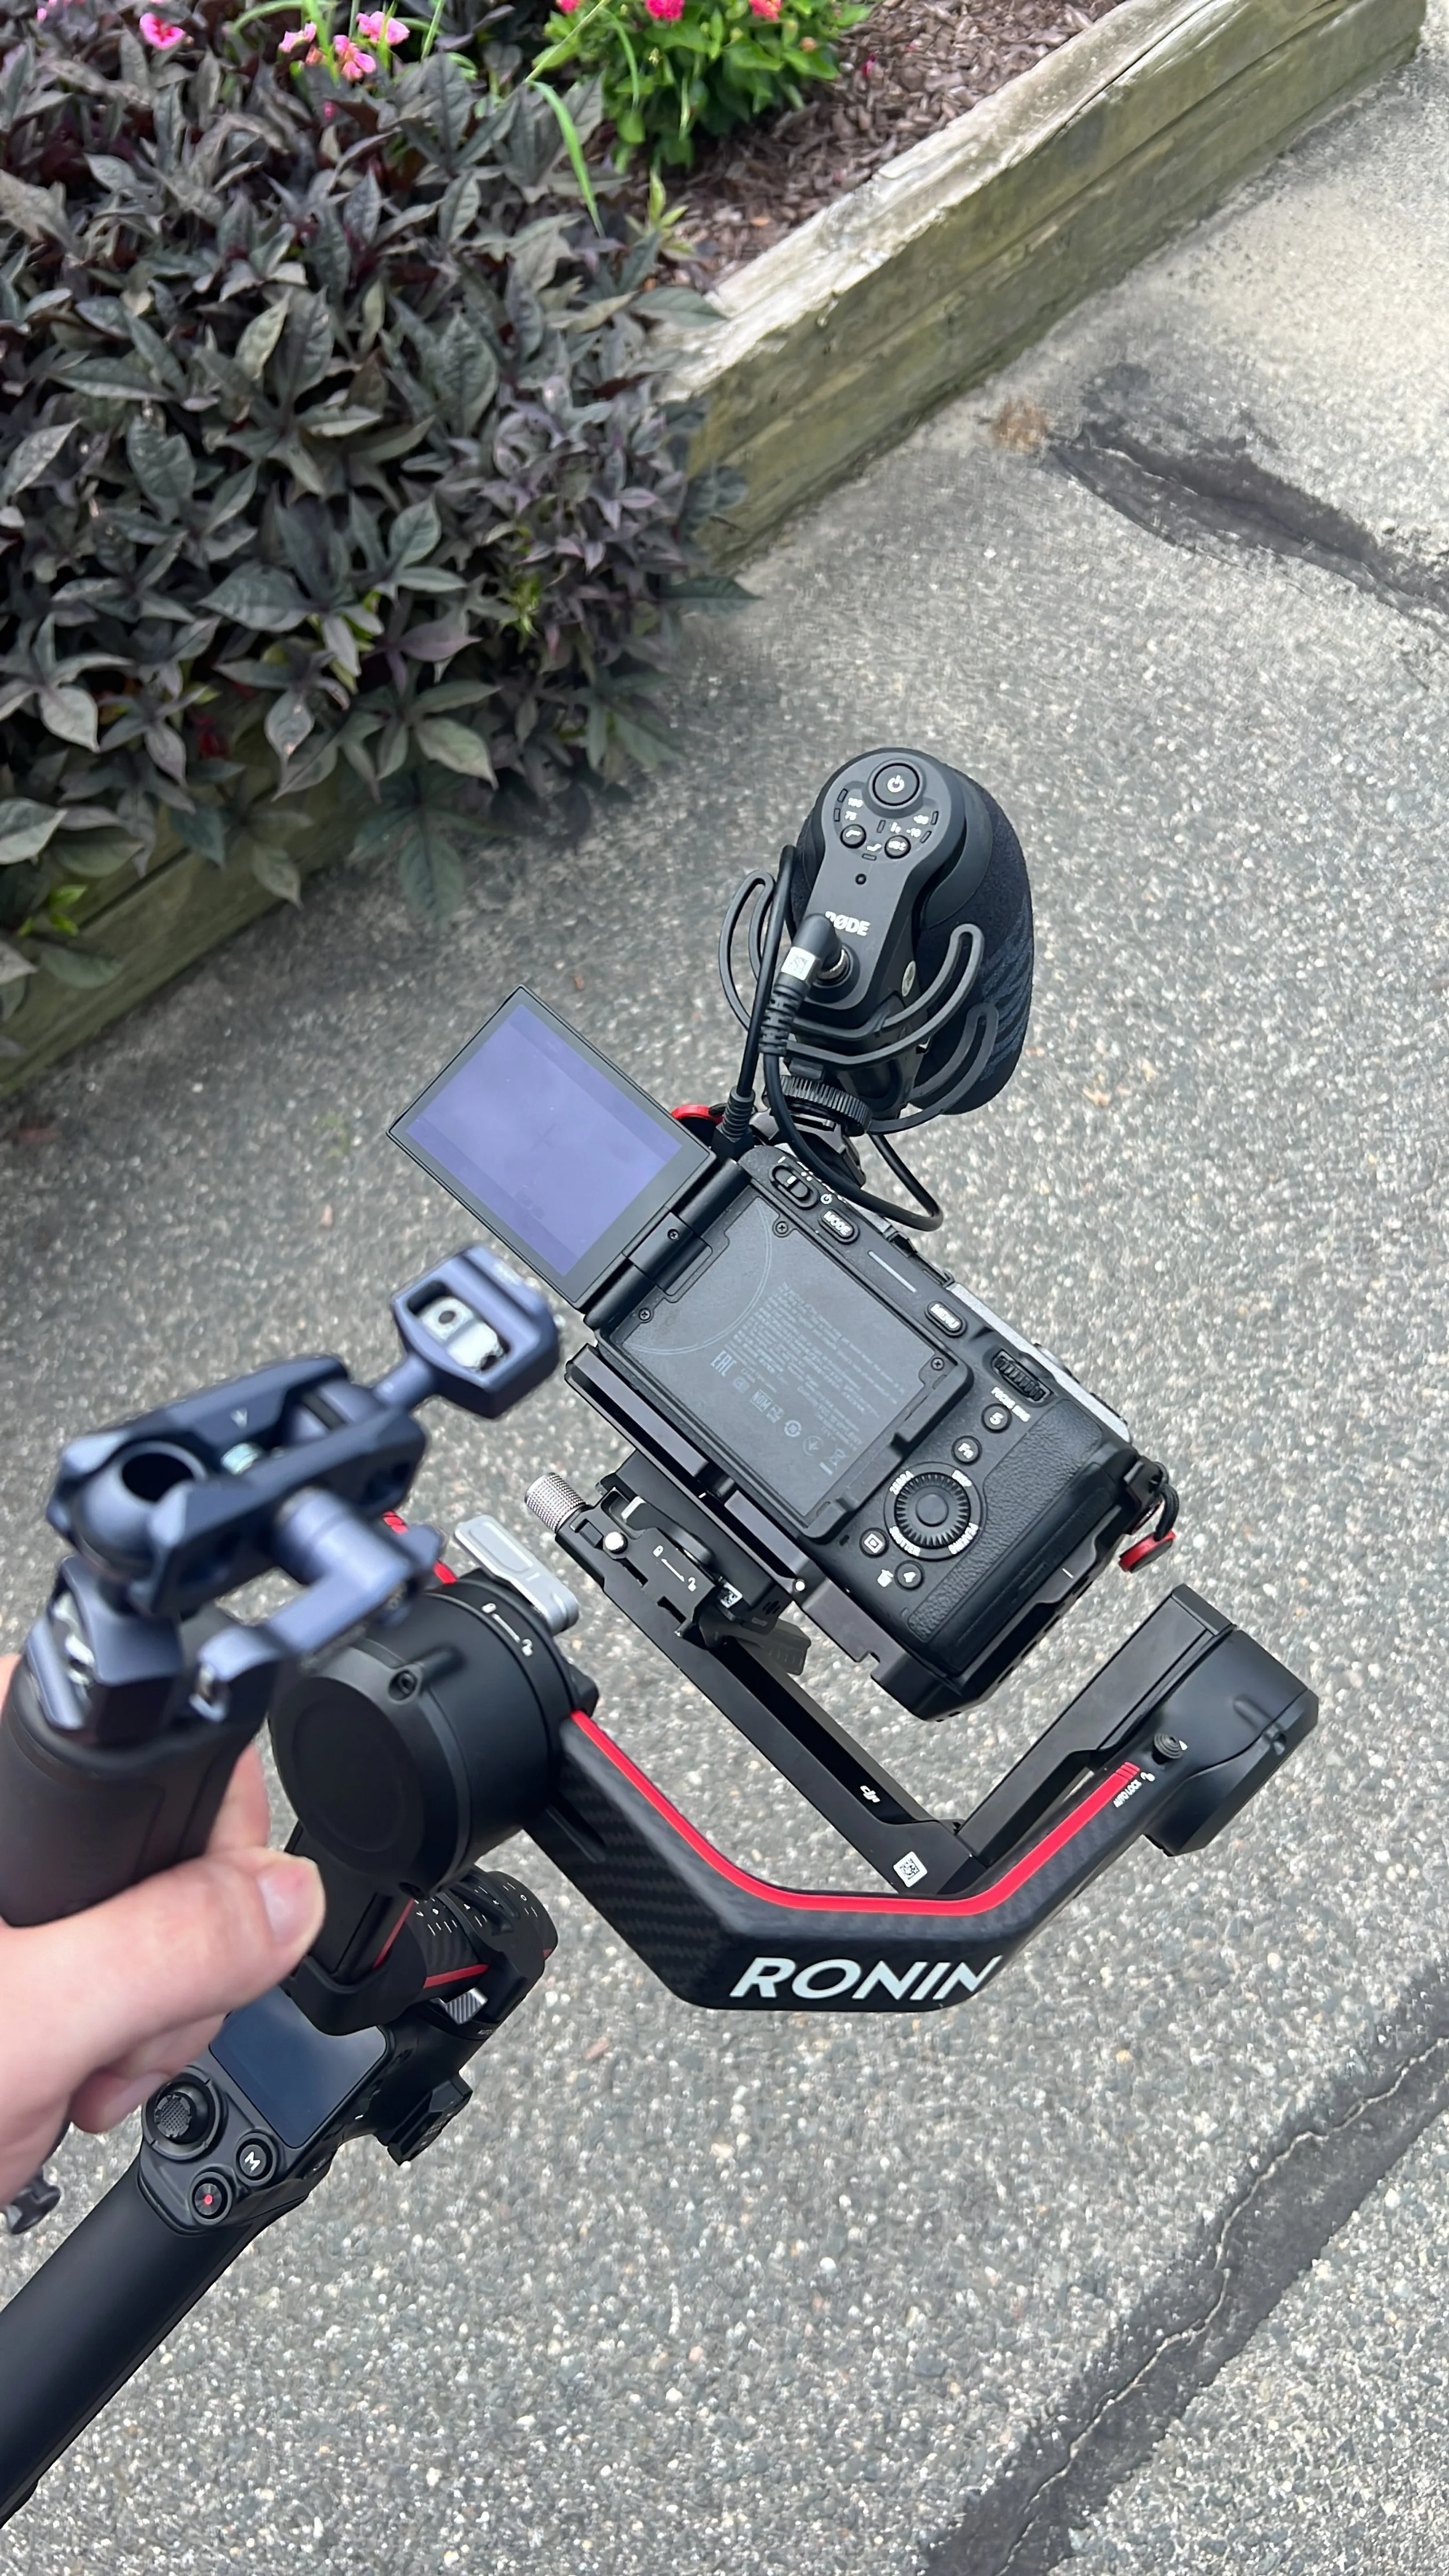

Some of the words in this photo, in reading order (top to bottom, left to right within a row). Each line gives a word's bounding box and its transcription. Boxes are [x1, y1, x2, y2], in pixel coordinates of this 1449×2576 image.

[824, 1210, 852, 1236] MODE
[930, 1303, 960, 1329] MENU
[991, 1387, 1015, 1409] FOCUS
[989, 1412, 1004, 1425] 5
[957, 1443, 974, 1459] Fn
[889, 1470, 915, 1496] ZEBRA
[952, 1469, 972, 1487] DISP
[889, 1526, 920, 1557] SHUTTER
[948, 1522, 978, 1555] PEAKING
[1113, 1791, 1129, 1807] AUTO
[1124, 1779, 1142, 1795] LOCK
[729, 1954, 1003, 2001] RONIN
[244, 2151, 261, 2172] M
